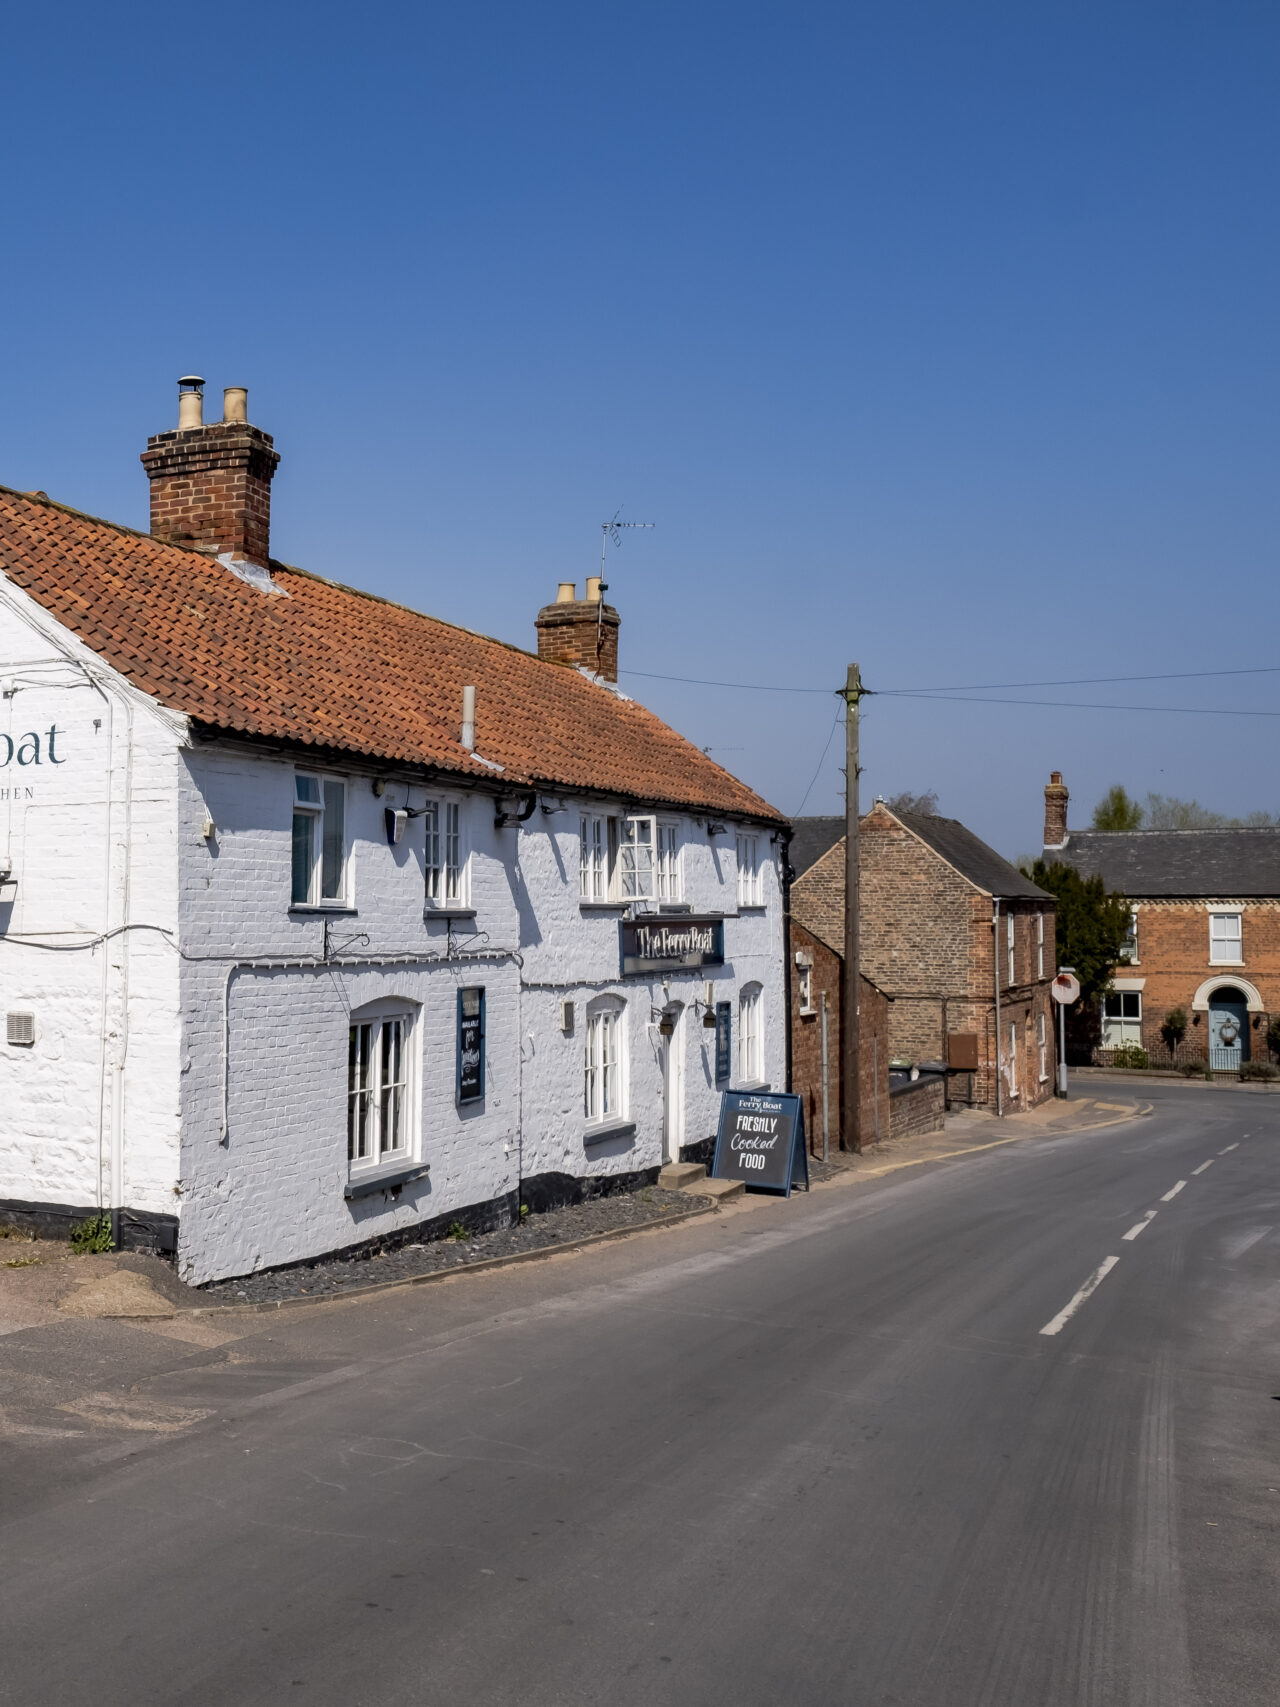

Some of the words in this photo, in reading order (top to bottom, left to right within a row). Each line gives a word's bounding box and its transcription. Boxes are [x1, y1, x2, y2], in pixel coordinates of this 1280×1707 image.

[637, 926, 661, 958] The
[661, 927, 691, 959] Ferry
[690, 926, 714, 954] Boat
[738, 1099, 762, 1110] Ferry
[762, 1101, 782, 1110] Boat
[736, 1115, 778, 1133] FRESHLY
[730, 1133, 779, 1150] Cooked
[738, 1152, 766, 1170] FOOD
